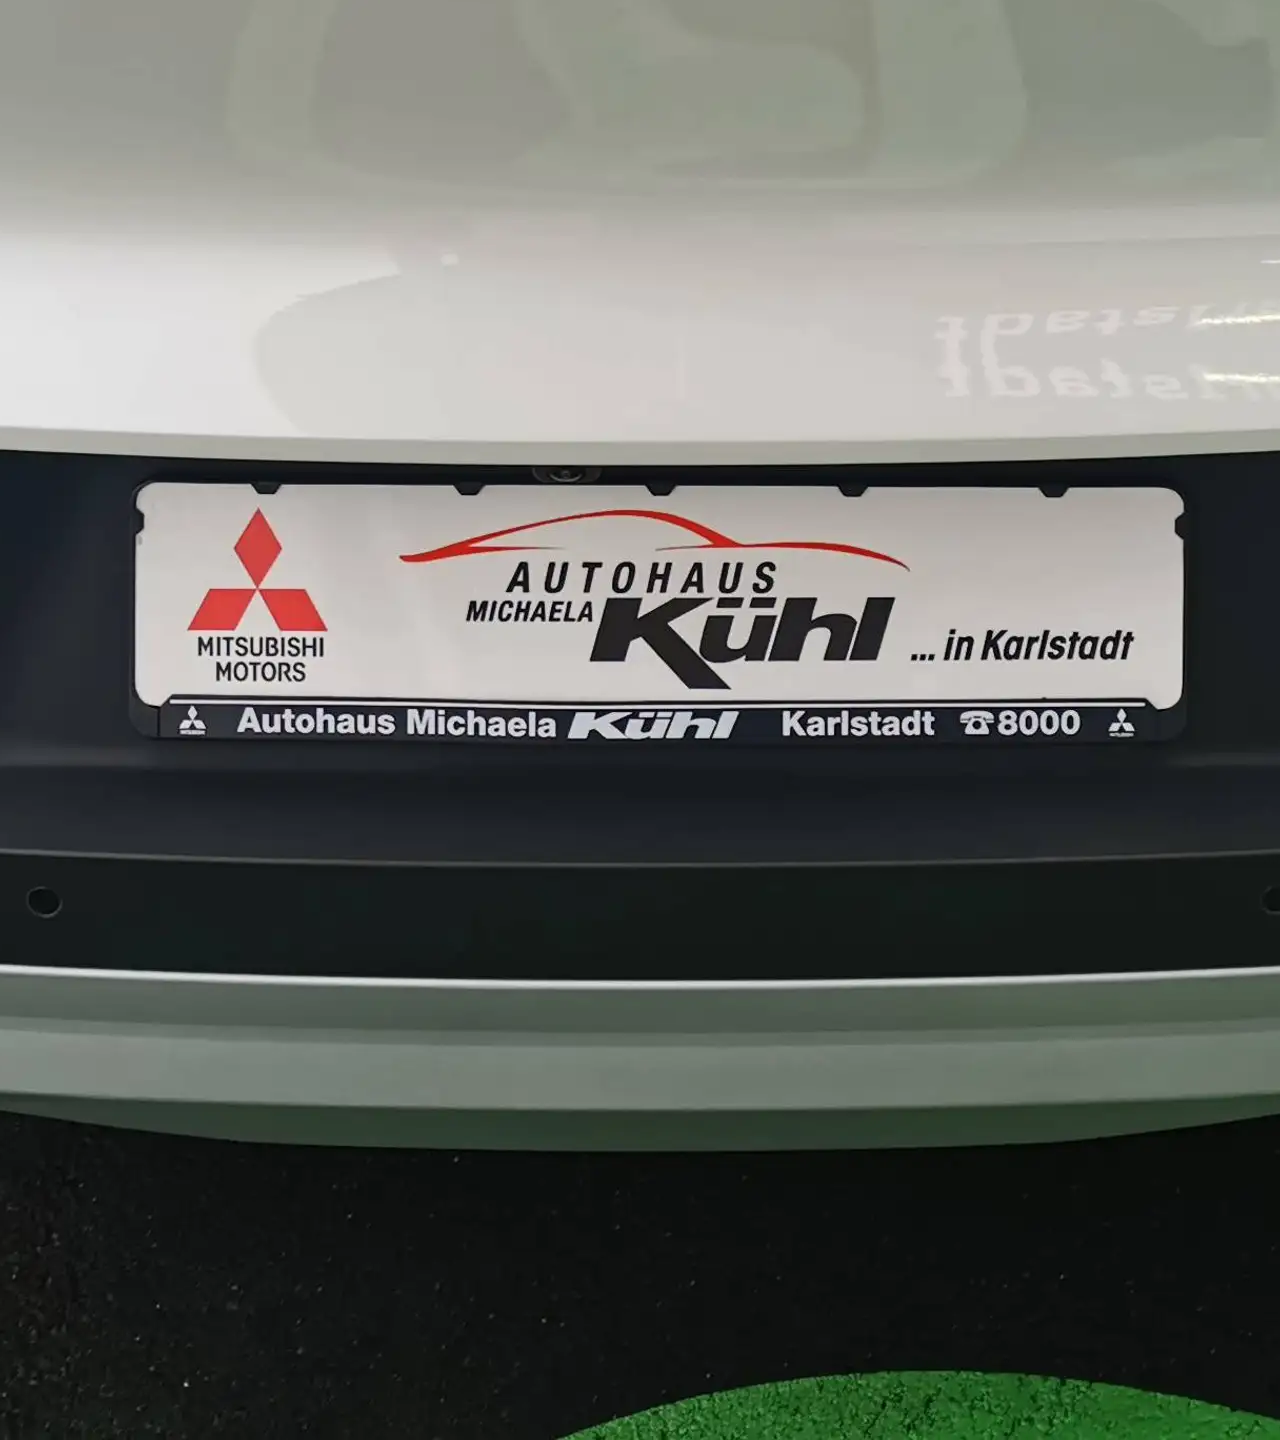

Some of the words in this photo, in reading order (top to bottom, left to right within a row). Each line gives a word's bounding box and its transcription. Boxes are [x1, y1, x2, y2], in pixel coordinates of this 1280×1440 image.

[505, 561, 777, 594] AUTOHAUS
[197, 636, 324, 658] MITSUBISHI
[465, 599, 594, 624] MICHAELA
[589, 596, 896, 690] Kühl
[943, 628, 975, 661] in
[980, 629, 1135, 662] Karlstadt
[215, 661, 306, 683] MOTORS
[236, 706, 396, 735] Autohaus
[406, 708, 557, 739] Michaela
[567, 709, 739, 740] Kühl
[780, 710, 936, 737] Karlstadt
[997, 709, 1081, 736] 8000
